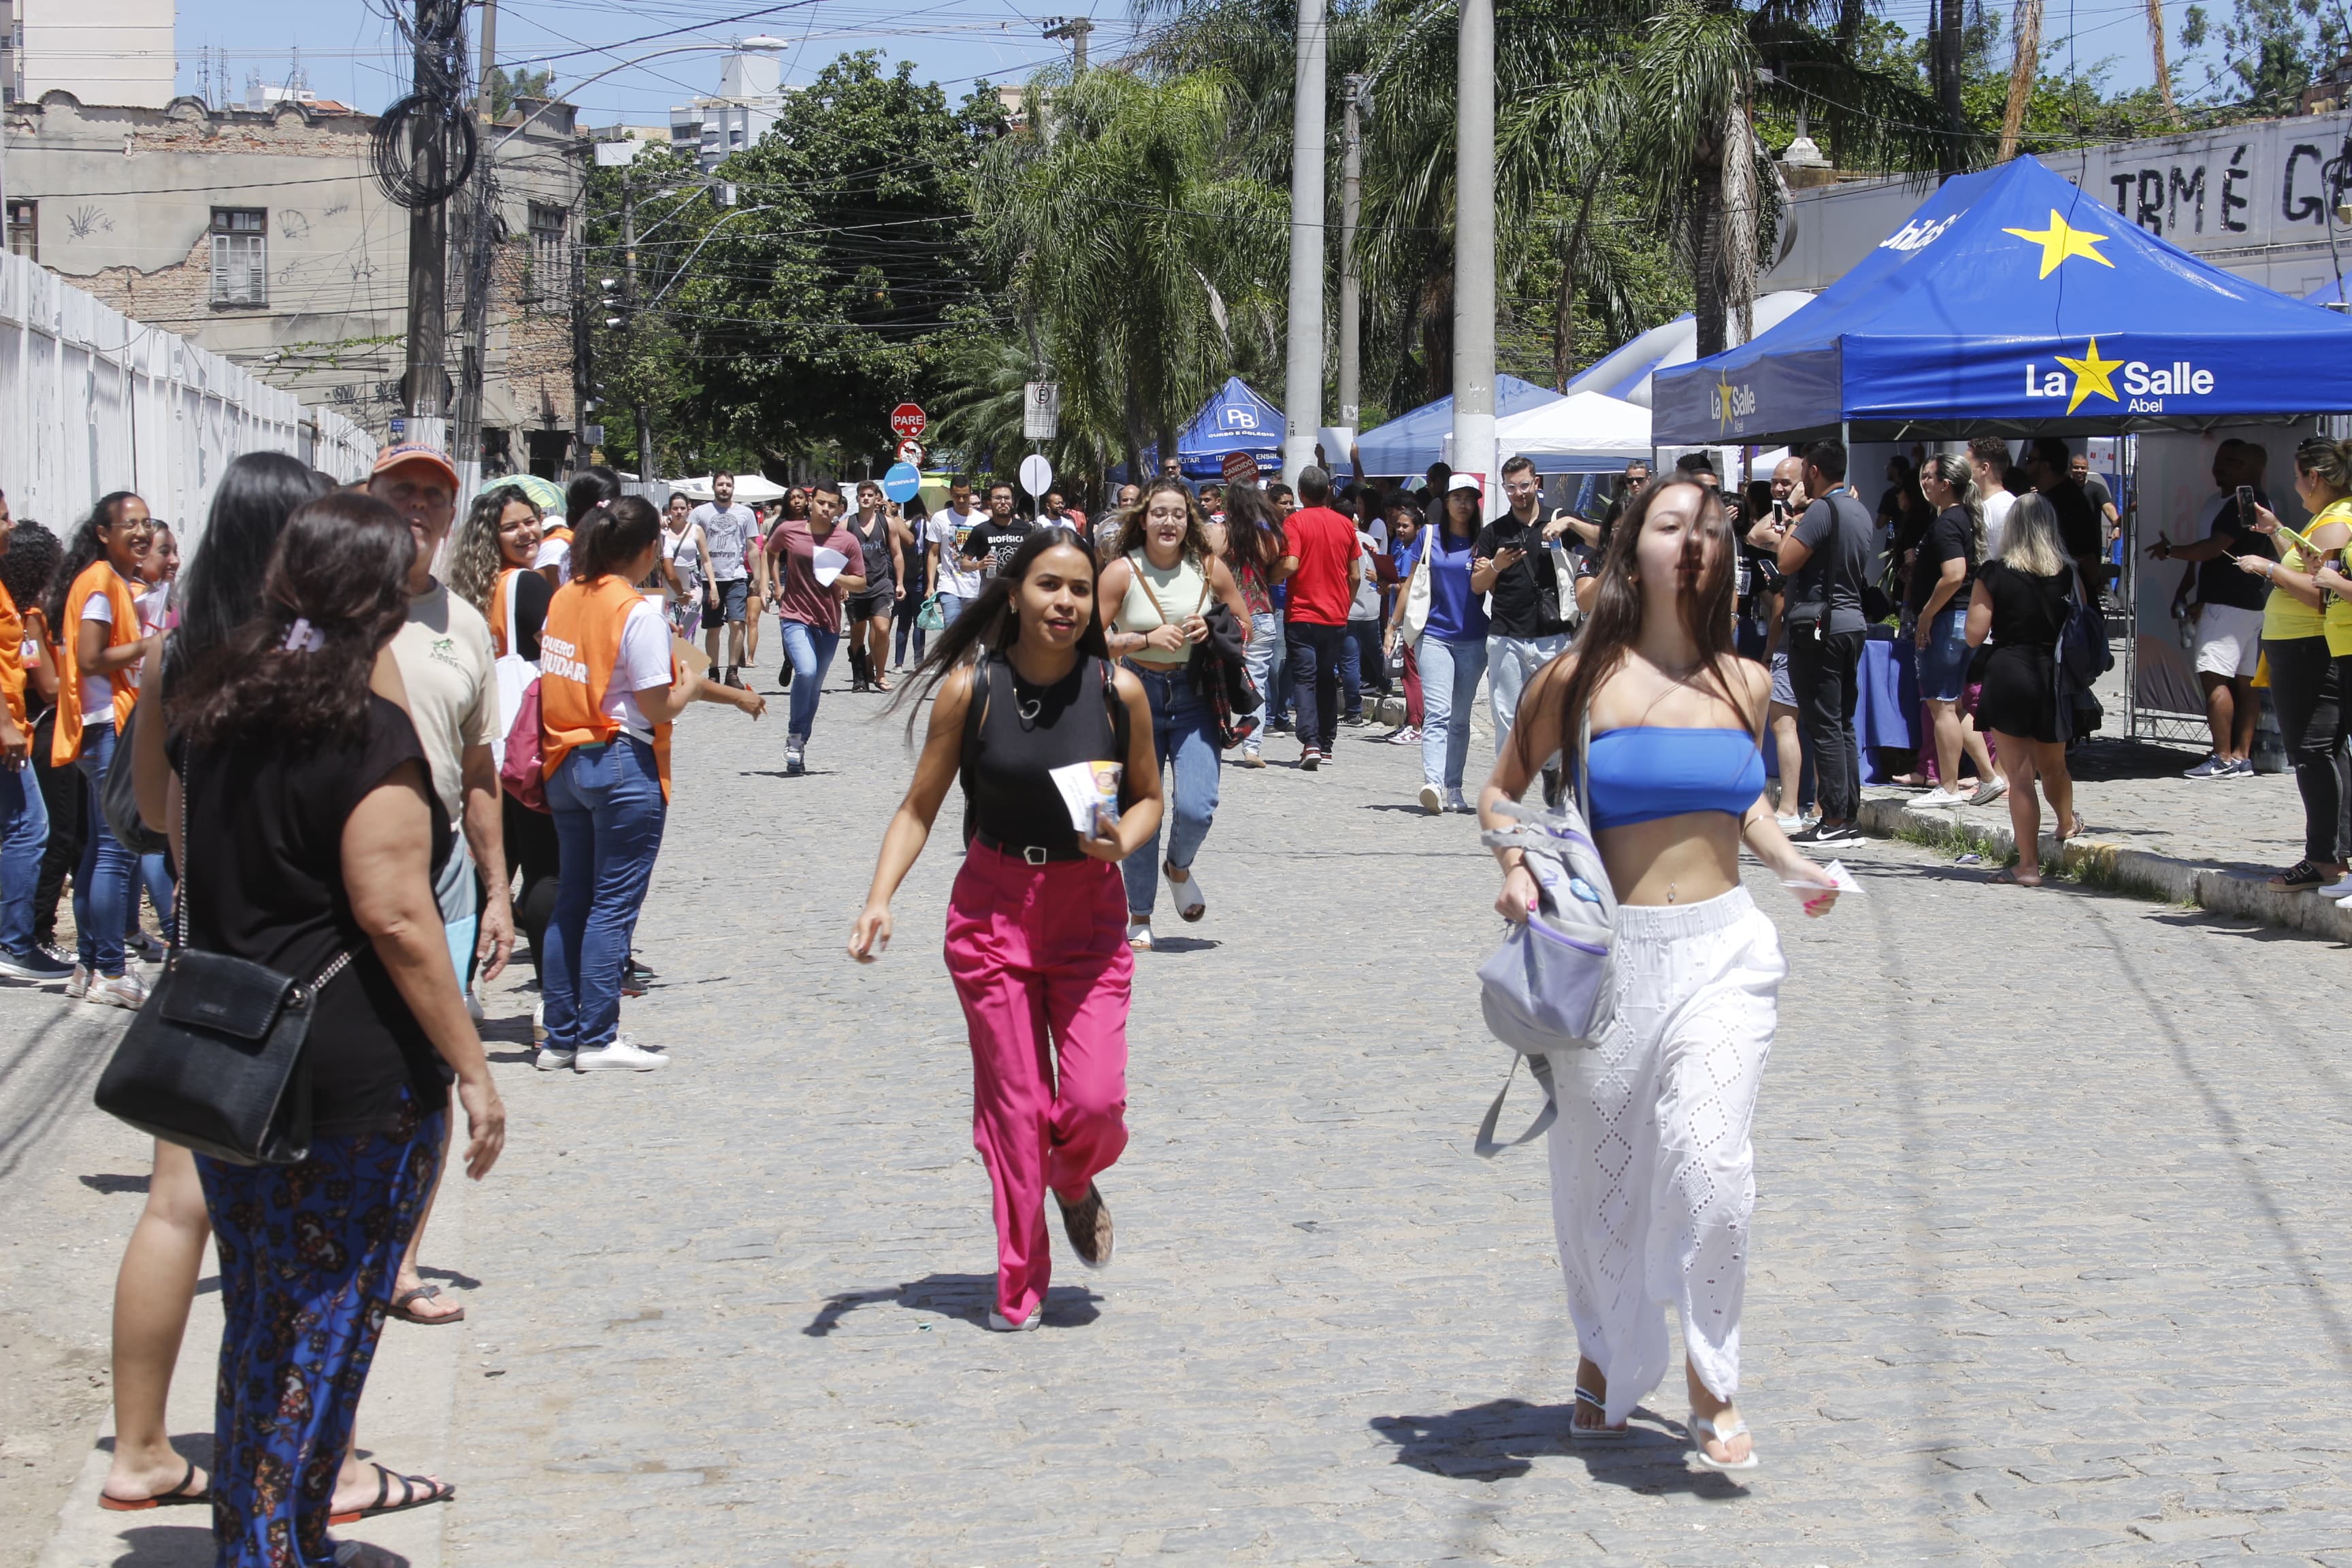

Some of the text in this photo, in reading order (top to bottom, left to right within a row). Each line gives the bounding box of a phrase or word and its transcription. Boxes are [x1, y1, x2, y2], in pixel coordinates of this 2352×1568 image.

[2026, 361, 2215, 397] La Salle
[1039, 389, 1045, 402] E
[1710, 384, 1756, 420] La Salle
[2128, 398, 2163, 412] Abel
[894, 415, 924, 425] PARE
[1227, 409, 1255, 428] PB
[1734, 419, 1744, 433] Abel
[1224, 459, 1253, 476] CANDIDO
[987, 534, 1024, 544] BIOFÍSICA
[542, 634, 576, 658] QUERO
